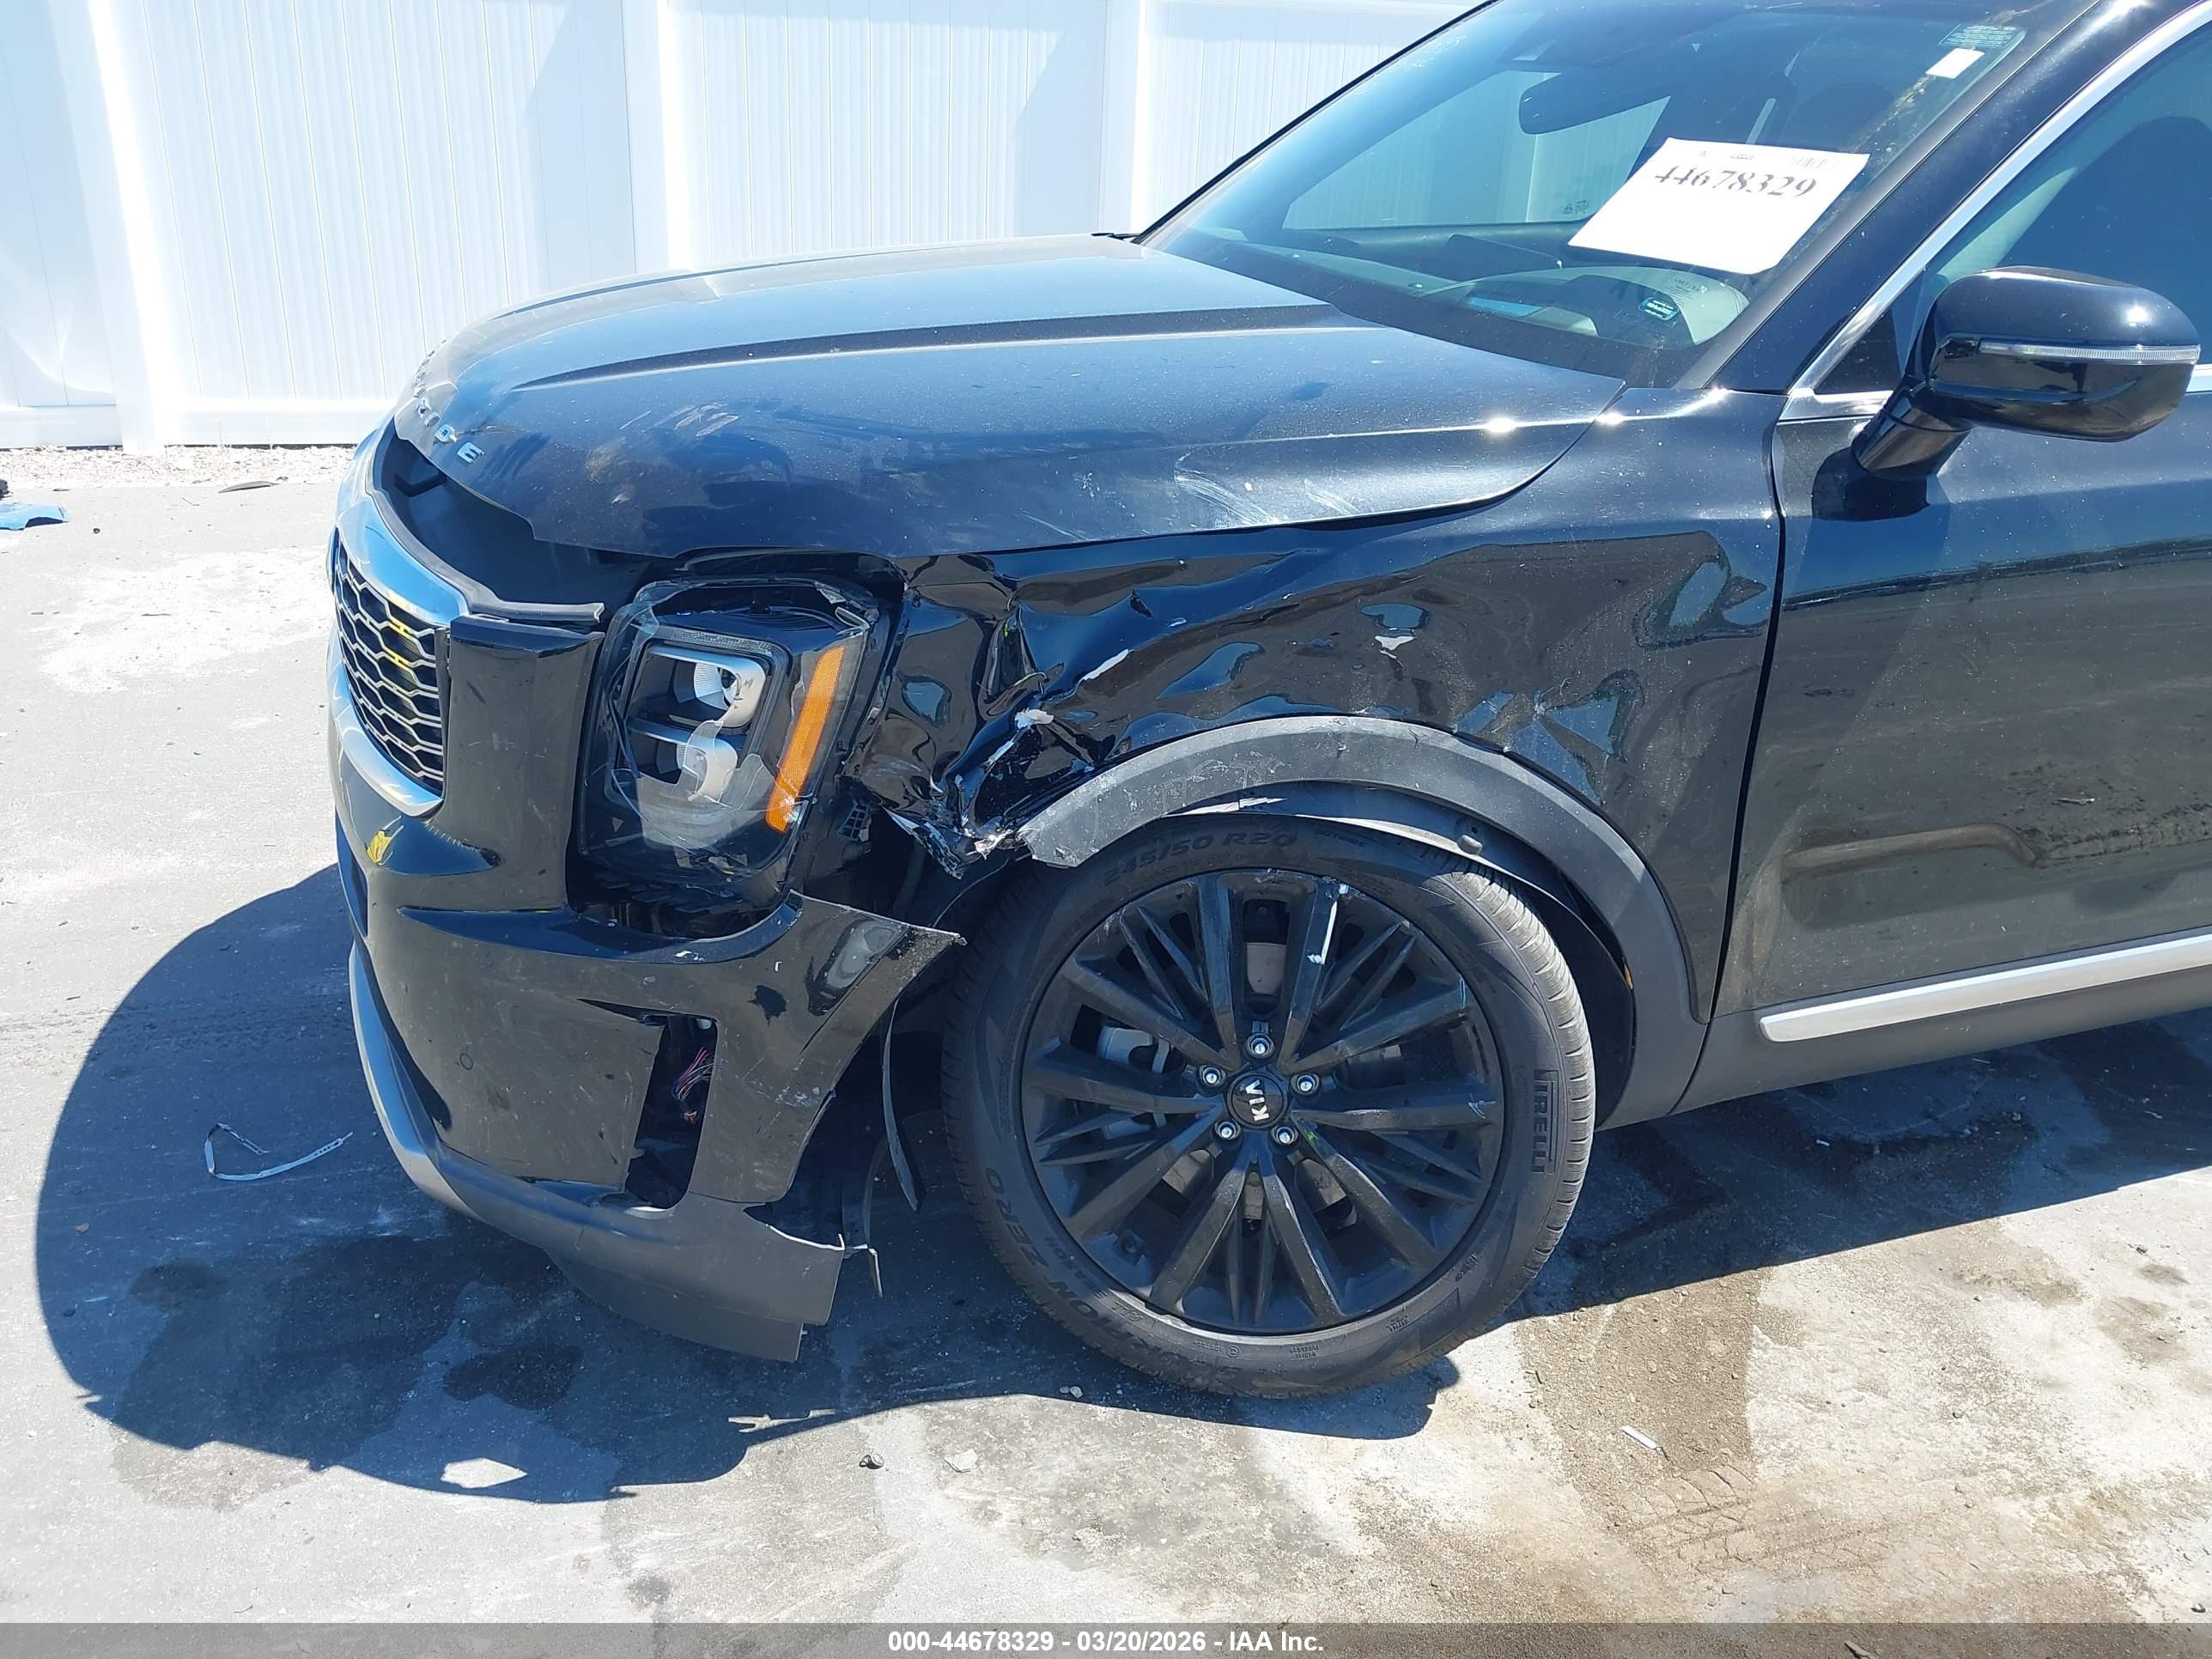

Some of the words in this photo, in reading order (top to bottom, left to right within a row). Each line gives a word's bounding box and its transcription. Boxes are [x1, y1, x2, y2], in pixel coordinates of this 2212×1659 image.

[1654, 165, 1818, 198] 44678329
[1245, 1079, 1270, 1121] KIA
[1534, 1069, 1559, 1173] PIRELLI
[986, 1169, 1048, 1271] ZERO
